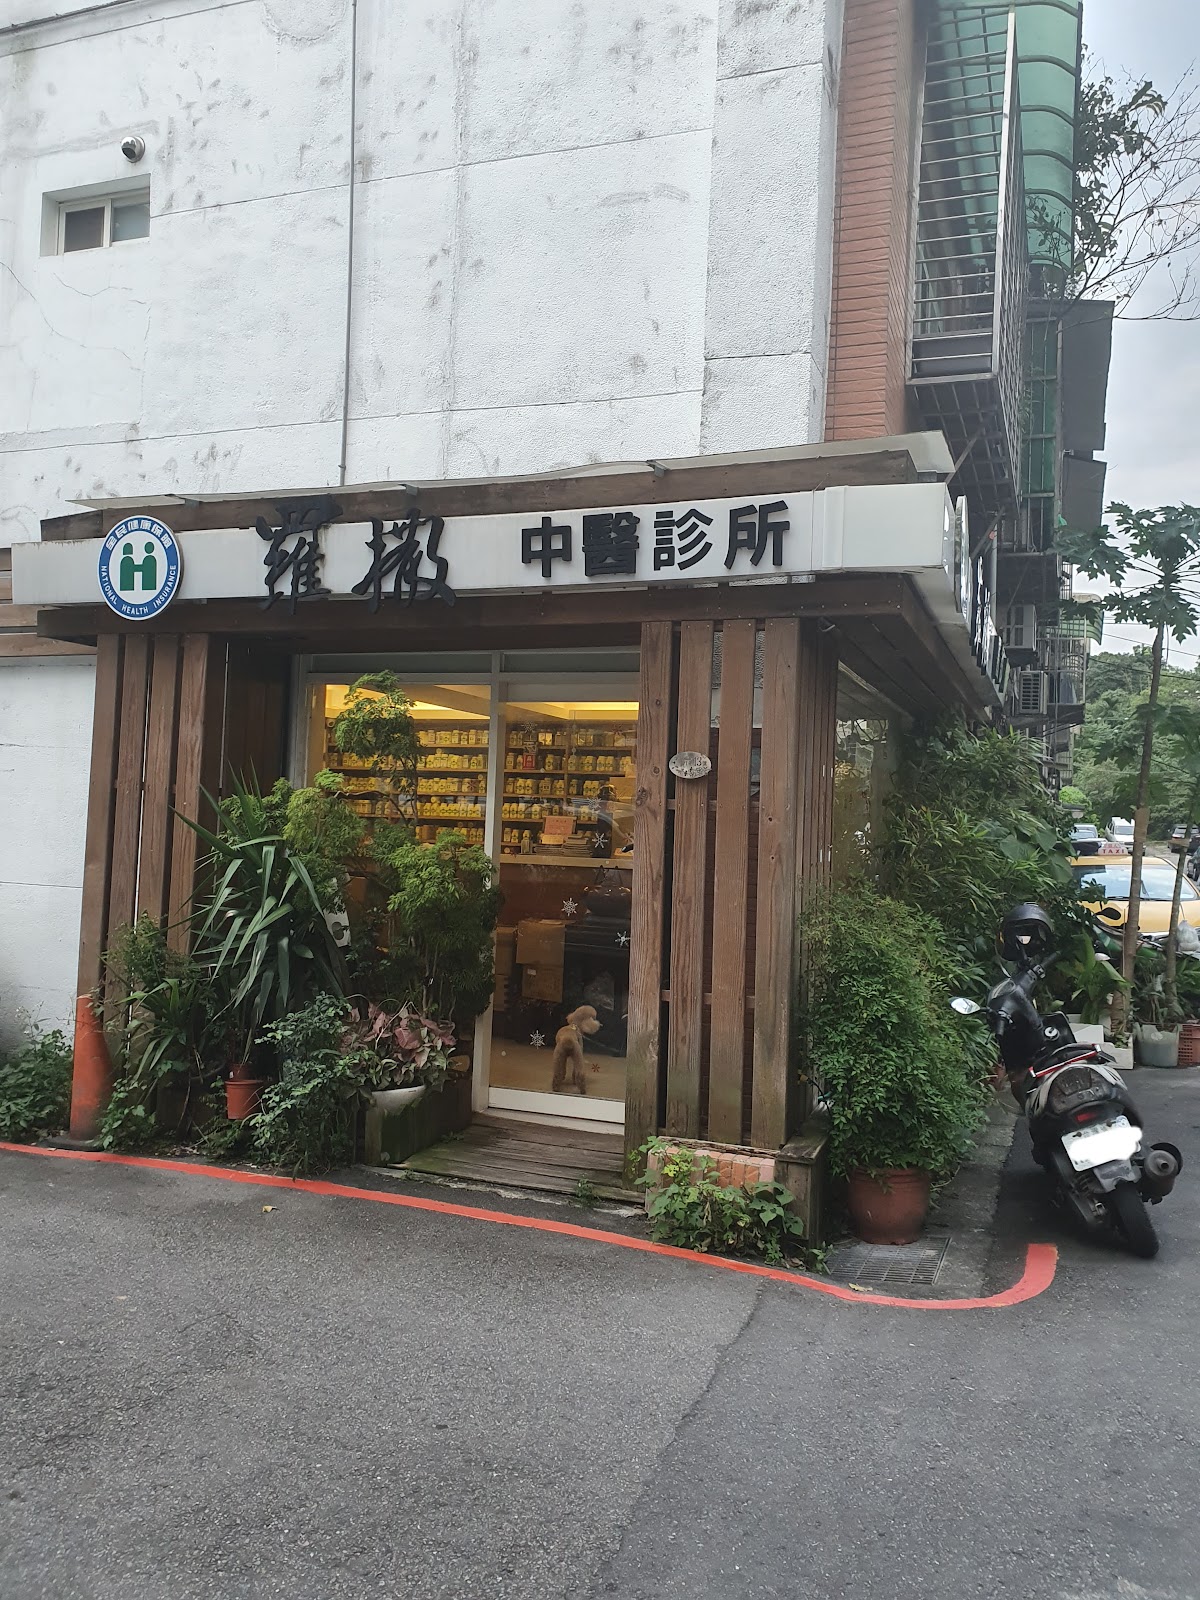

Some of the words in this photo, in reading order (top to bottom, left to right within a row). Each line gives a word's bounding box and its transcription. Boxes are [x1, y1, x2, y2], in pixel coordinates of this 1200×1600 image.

[521, 499, 791, 578] 中醫診所
[101, 565, 118, 605] NATIONAL
[121, 603, 149, 615] HEALTH
[152, 564, 177, 609] INSURANCE
